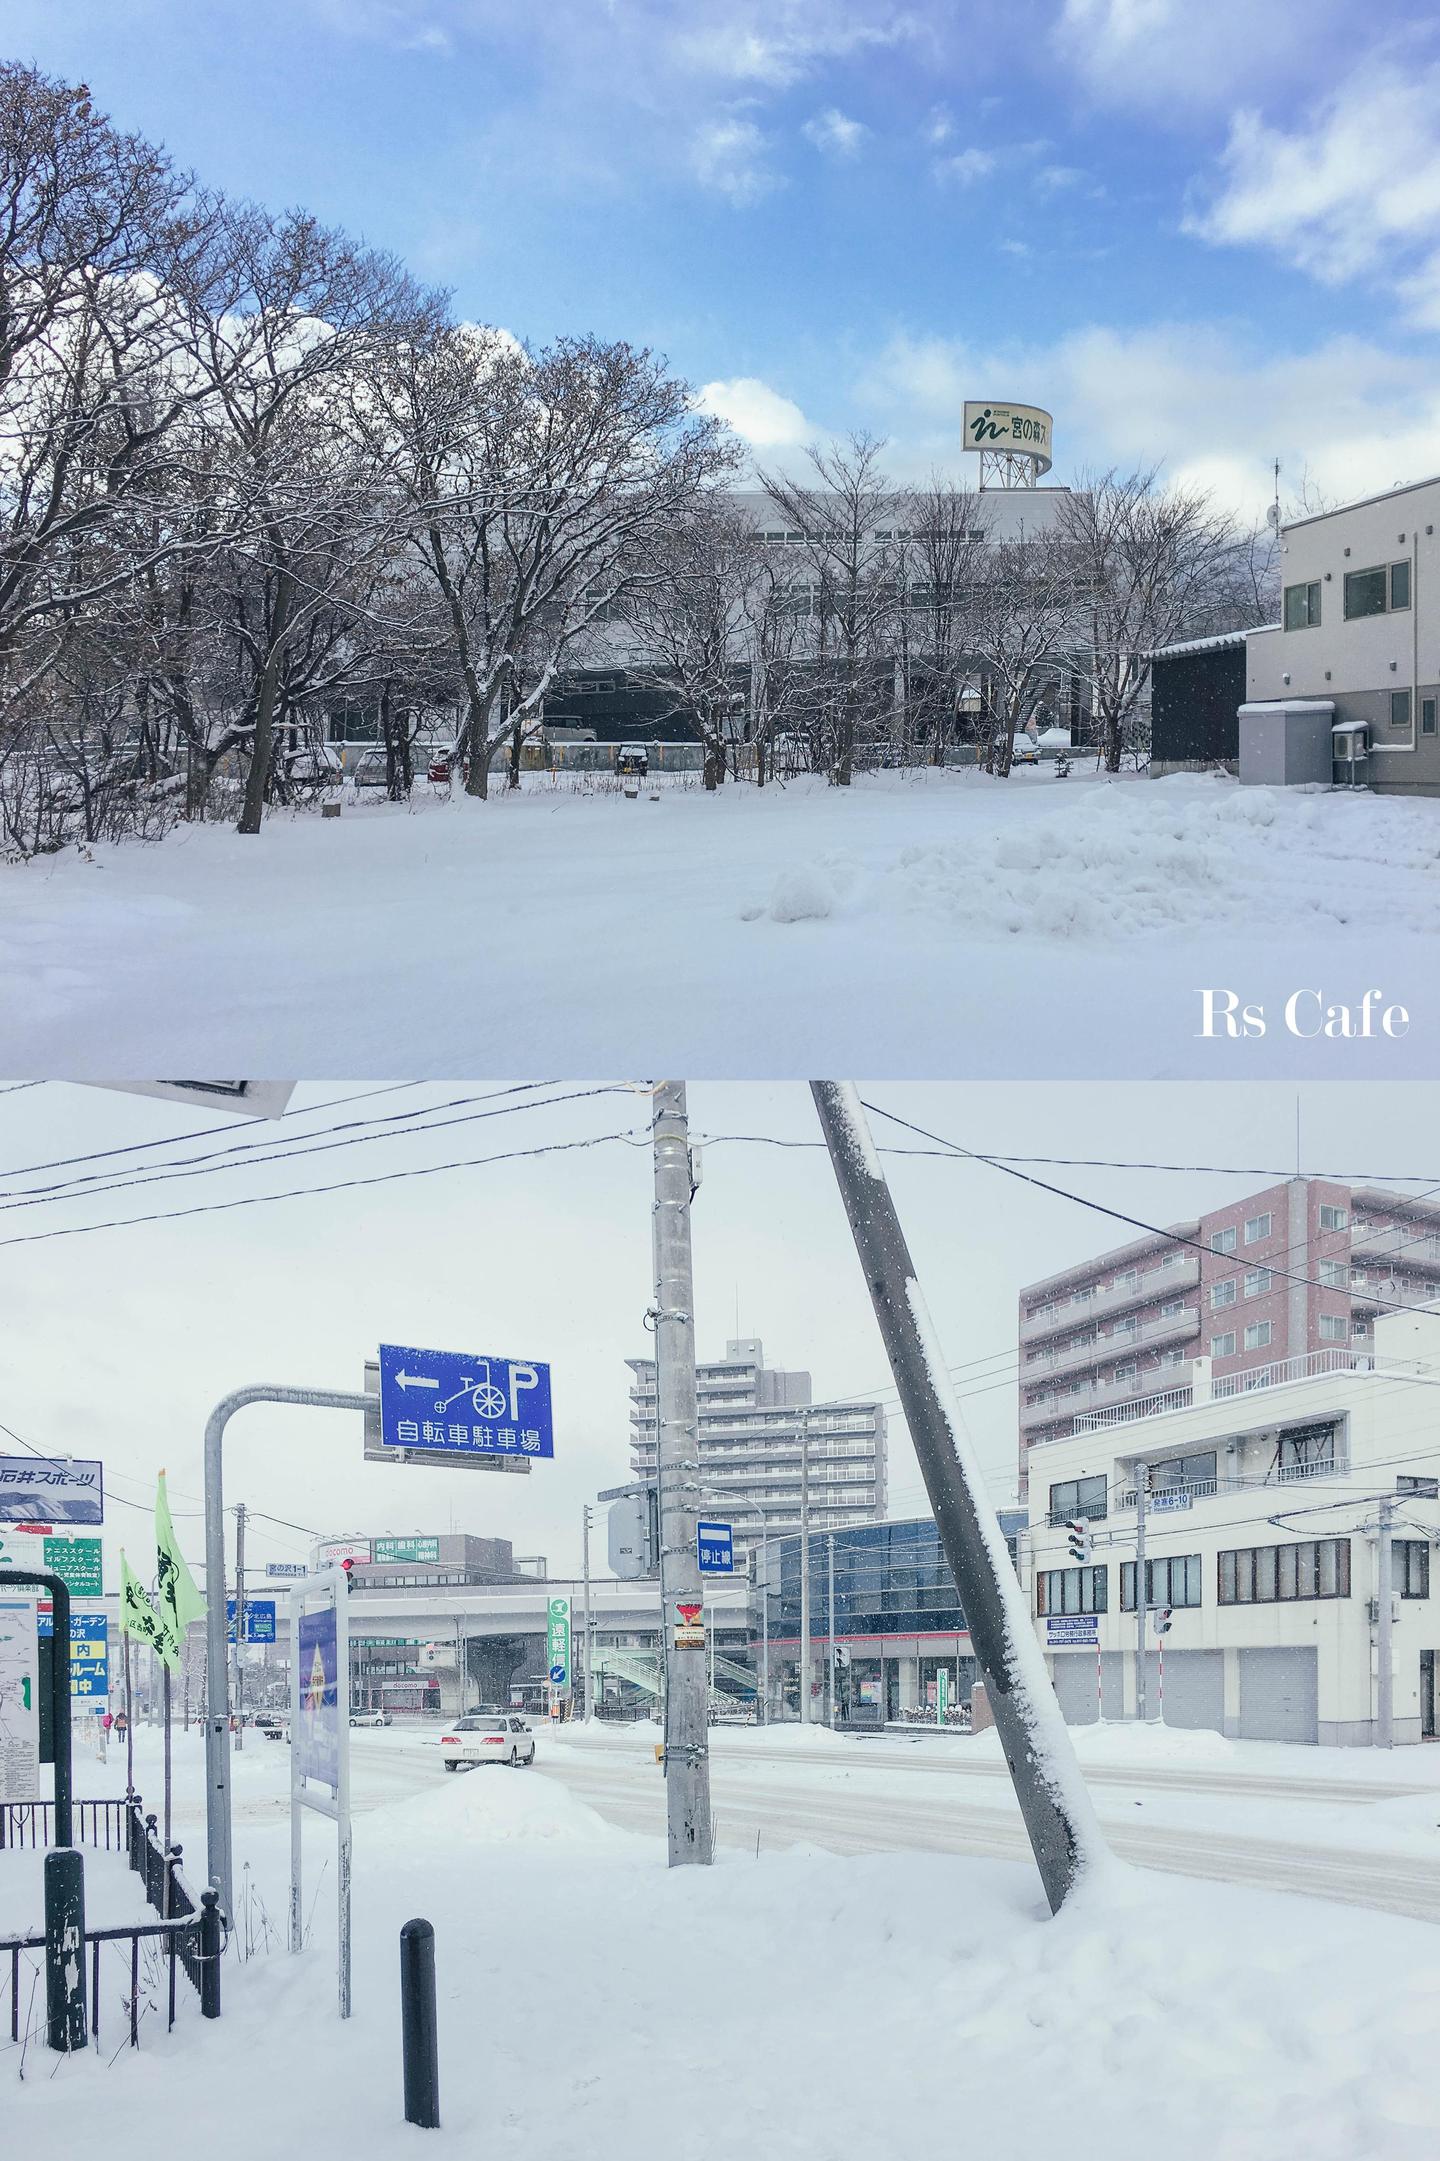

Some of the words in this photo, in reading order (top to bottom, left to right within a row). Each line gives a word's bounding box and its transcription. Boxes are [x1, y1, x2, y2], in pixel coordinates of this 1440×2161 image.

[508, 1363, 539, 1421] P
[397, 1420, 541, 1452] 自転車駐車場
[0, 1469, 95, 1486] 石井スポーツ
[700, 1549, 732, 1565] 停止線
[77, 1644, 90, 1656] 内
[552, 1623, 565, 1667] 遠軽信
